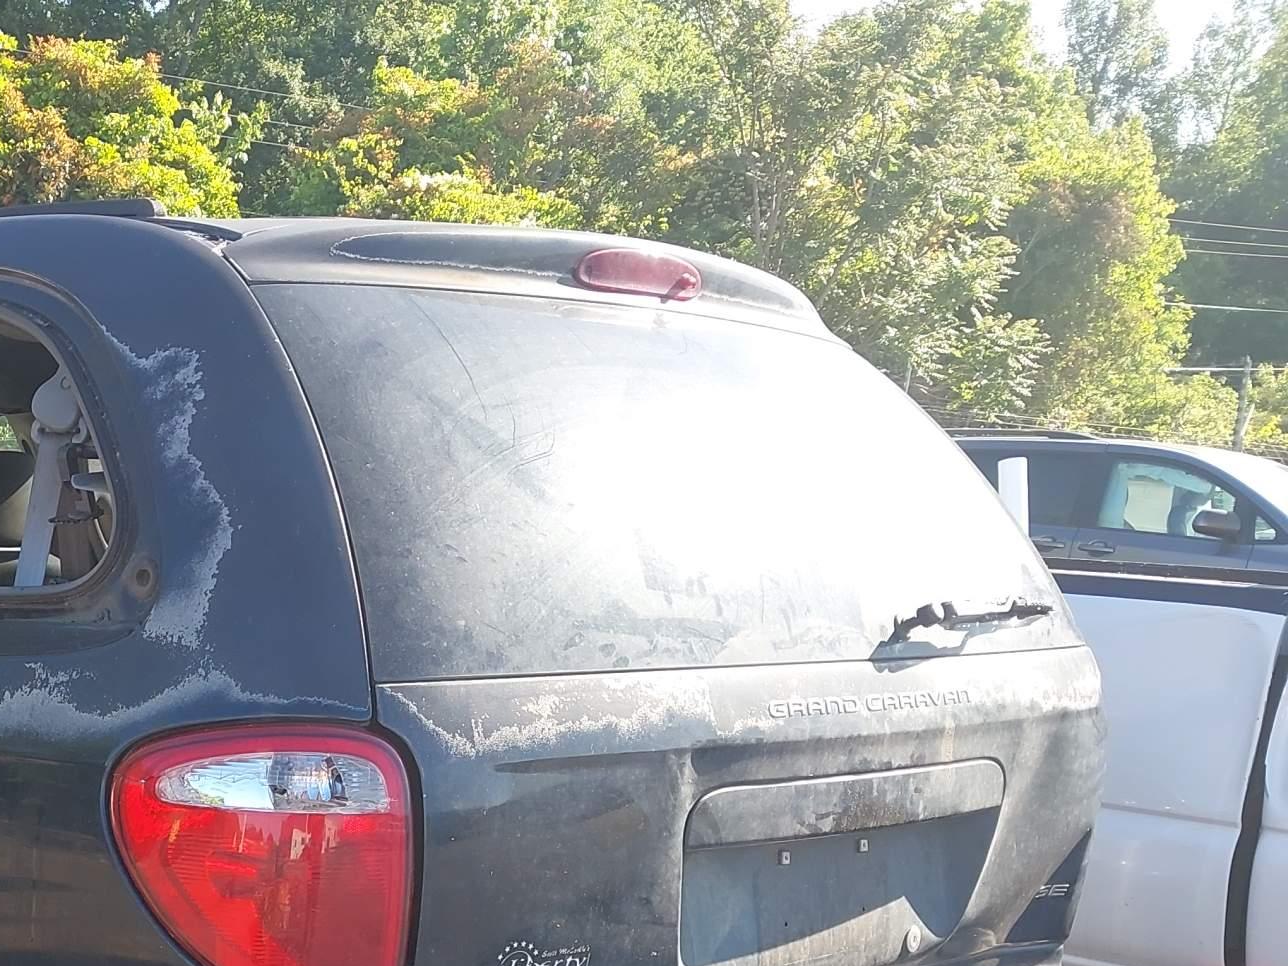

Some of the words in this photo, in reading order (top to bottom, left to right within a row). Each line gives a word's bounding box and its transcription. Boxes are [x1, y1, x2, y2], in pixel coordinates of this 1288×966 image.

[767, 697, 859, 719] GRAND
[865, 689, 971, 713] CARAVAN
[1035, 883, 1070, 899] SE
